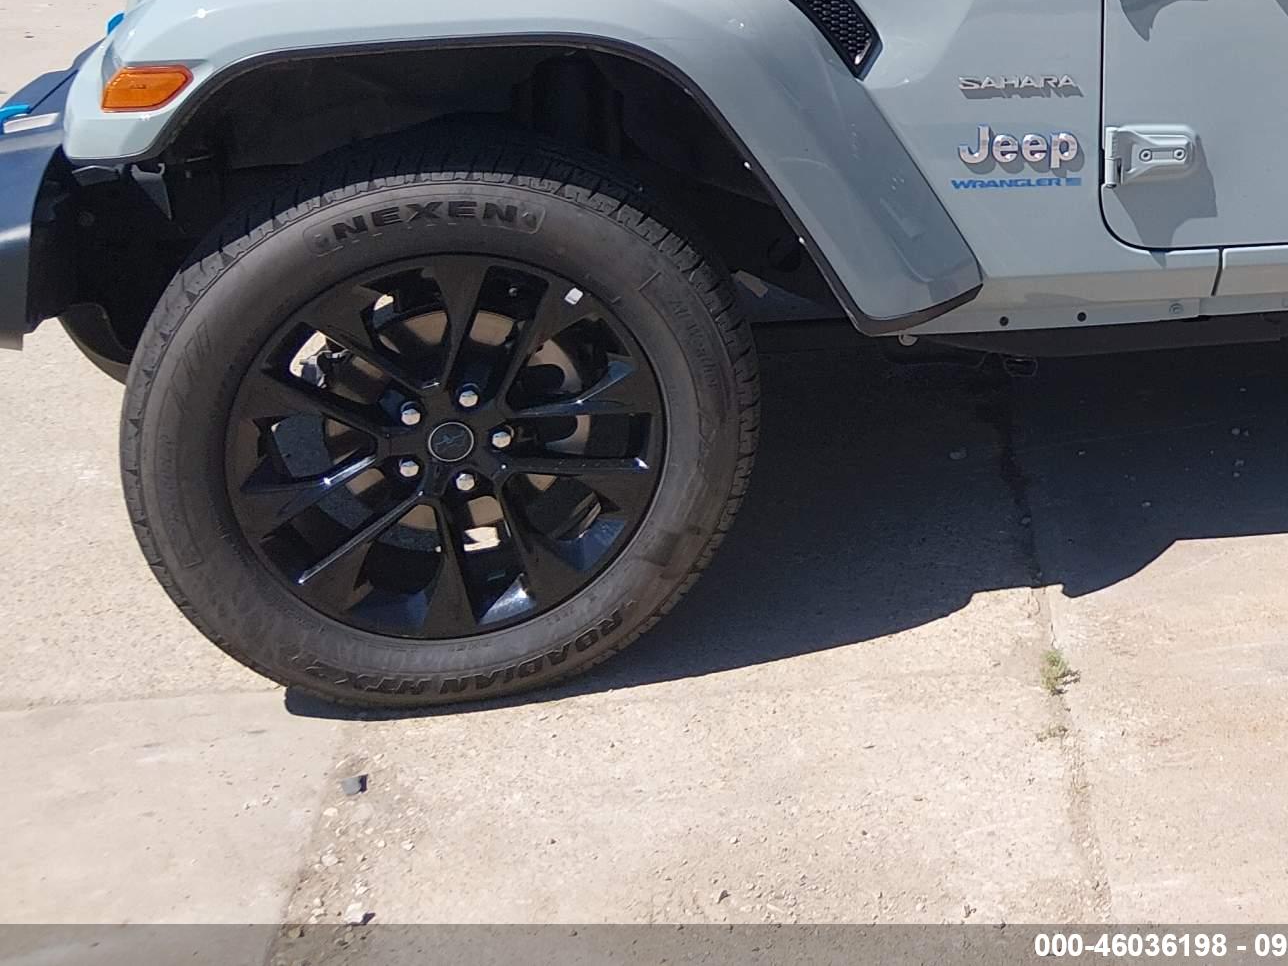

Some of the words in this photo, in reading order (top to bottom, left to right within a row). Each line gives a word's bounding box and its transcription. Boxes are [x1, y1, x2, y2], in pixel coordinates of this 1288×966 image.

[958, 75, 1077, 90] SAHARA
[957, 123, 1079, 169] Jeep
[951, 177, 1061, 190] WRANGLER
[332, 200, 519, 241] NEXEN
[438, 609, 625, 696] ROADIAN
